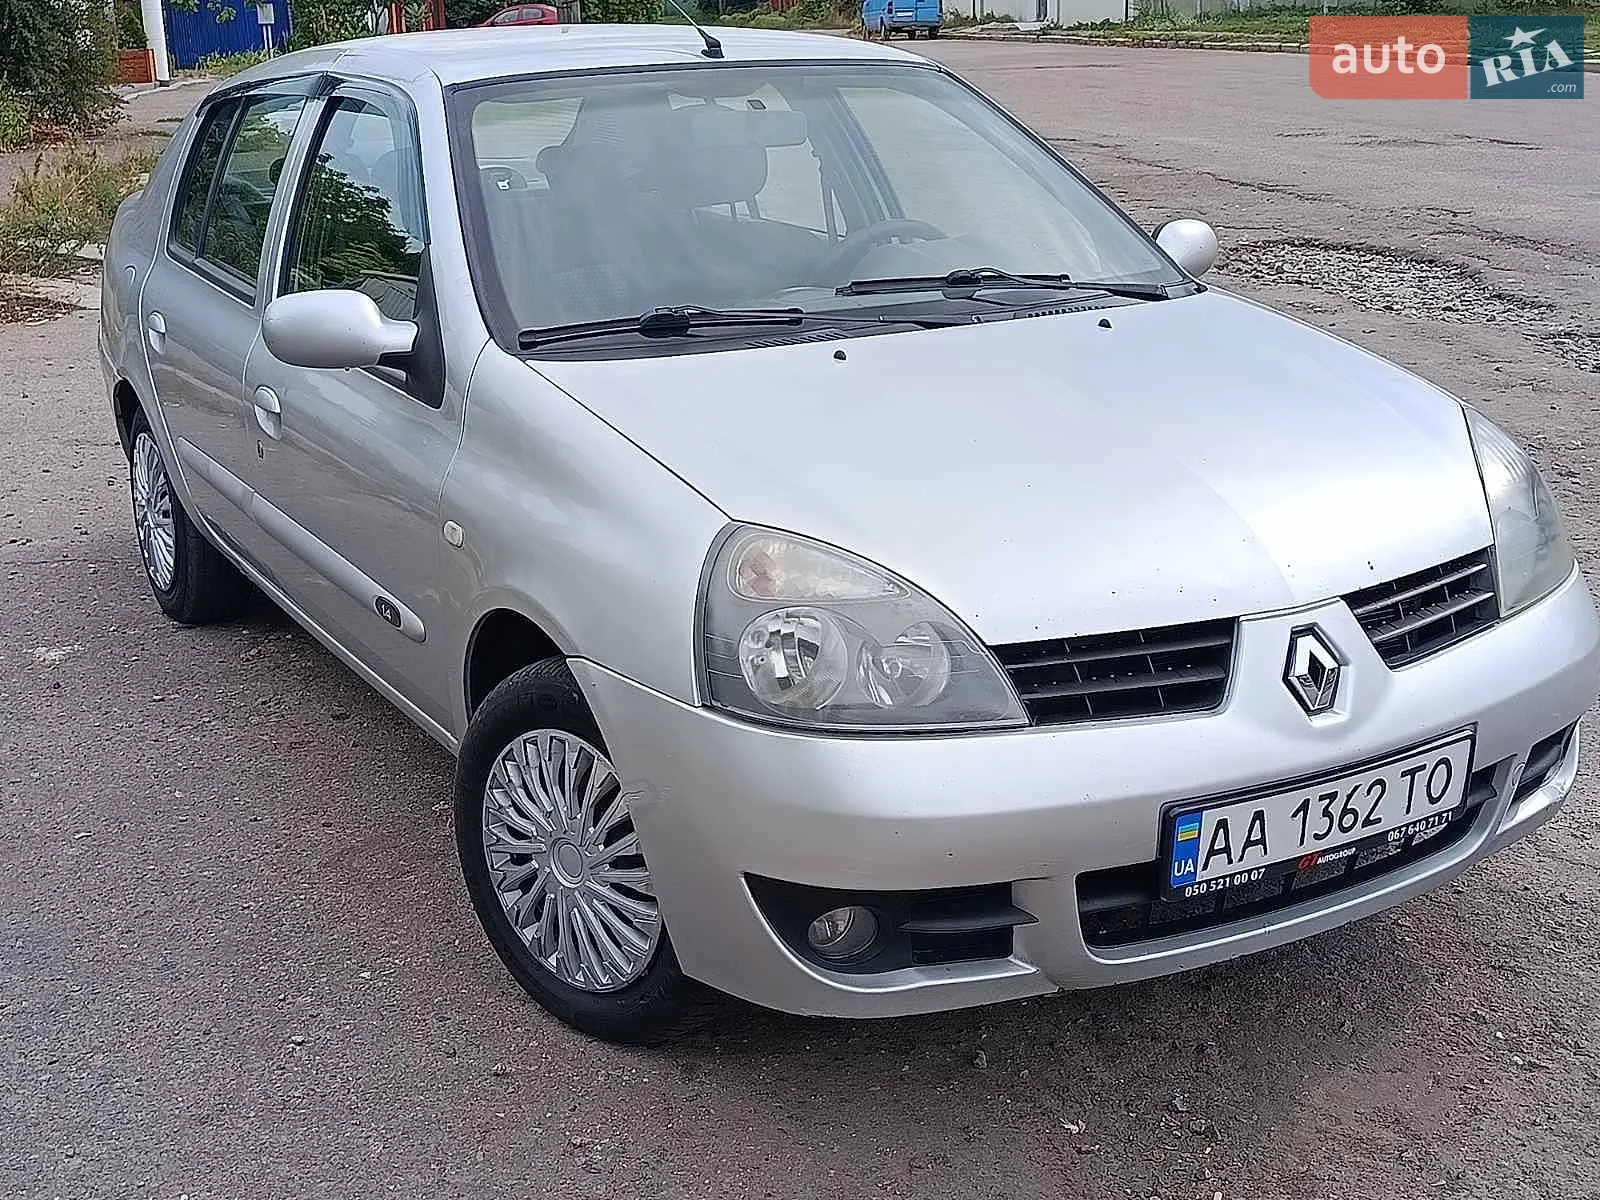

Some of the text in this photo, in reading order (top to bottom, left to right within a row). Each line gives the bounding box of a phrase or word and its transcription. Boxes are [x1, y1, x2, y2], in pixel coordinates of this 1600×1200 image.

[1201, 756, 1453, 872] AA 1362 TO
[1387, 810, 1453, 842] 067 640 71 71
[1174, 858, 1195, 876] UA
[1184, 867, 1266, 898] 050 521 00 07
